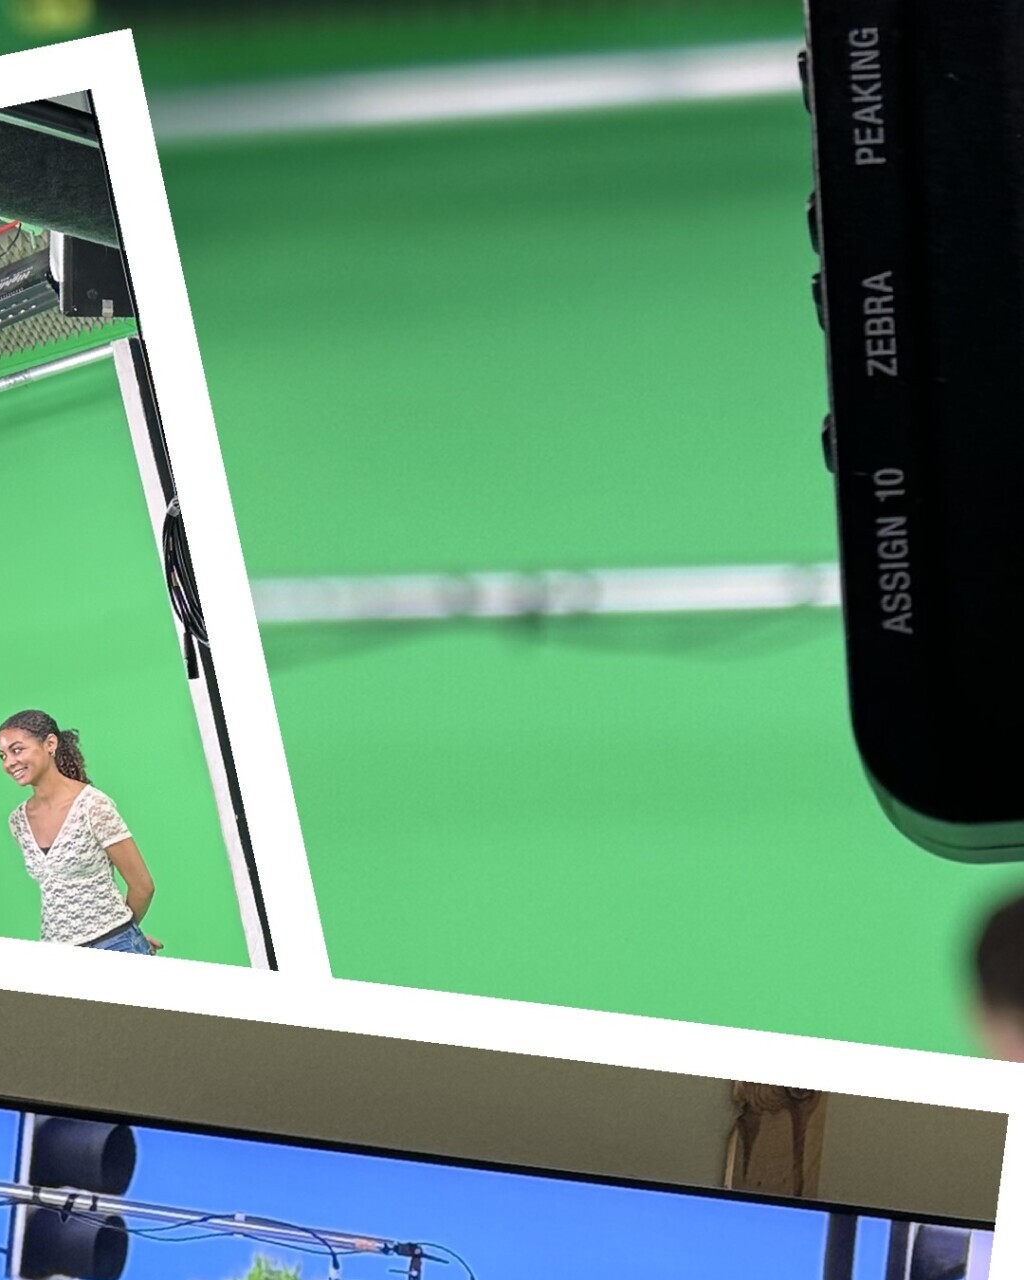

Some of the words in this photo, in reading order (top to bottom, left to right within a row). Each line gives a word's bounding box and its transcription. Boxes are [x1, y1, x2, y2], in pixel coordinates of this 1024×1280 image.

[848, 27, 887, 165] PEAKING
[862, 270, 898, 377] ZEBRA
[874, 468, 906, 502] 10
[875, 516, 913, 635] ASSIGN
